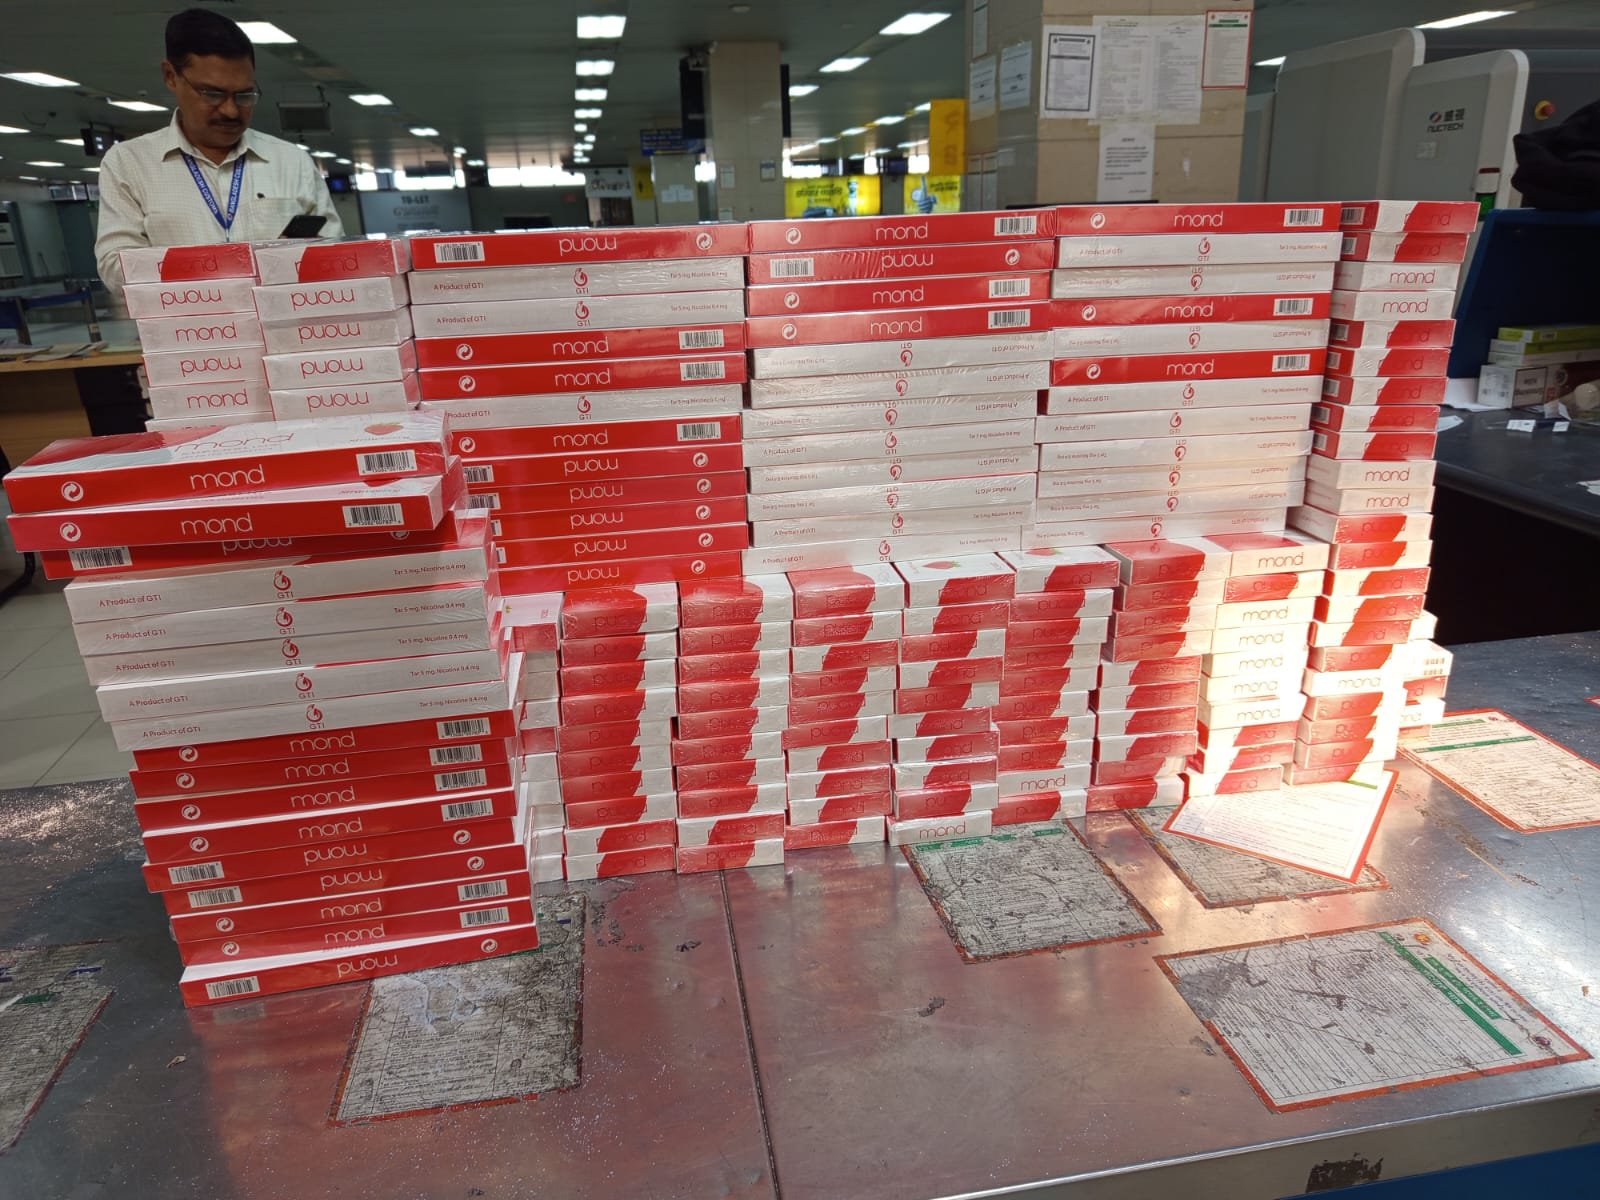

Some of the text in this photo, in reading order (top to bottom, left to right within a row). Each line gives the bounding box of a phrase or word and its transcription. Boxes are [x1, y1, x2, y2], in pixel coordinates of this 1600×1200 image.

[202, 188, 218, 214] CUSTOMS
[1174, 211, 1223, 227] mond
[876, 222, 928, 241] mond
[559, 236, 616, 256] mond
[882, 252, 933, 271] mond
[1390, 269, 1436, 284] mond
[160, 288, 222, 310] mond
[290, 288, 354, 310] mond
[873, 284, 924, 304] mond
[1165, 302, 1213, 318] mond
[1382, 299, 1429, 313] mond
[176, 322, 236, 342] mond
[298, 323, 360, 344] mond
[870, 316, 922, 335] mond
[553, 336, 608, 356] mond
[180, 356, 242, 376] mond
[301, 358, 364, 378] mond
[1167, 360, 1214, 376] mond
[555, 368, 610, 386] mond
[187, 388, 248, 408] mond
[307, 392, 370, 412] mond
[174, 432, 294, 452] mond
[554, 428, 608, 448] mond
[190, 464, 265, 489] mond
[564, 457, 618, 476] mond
[1365, 468, 1410, 482] mond
[570, 484, 623, 502] mond
[1366, 494, 1410, 508] mond
[181, 511, 253, 536] mond
[570, 511, 623, 529] mond
[574, 538, 626, 556] mond
[1259, 552, 1304, 568] mond
[568, 566, 619, 584] mond
[277, 590, 294, 599] GTI
[1243, 606, 1288, 622] mond
[280, 627, 295, 635] GTI
[1240, 632, 1284, 647] mond
[1239, 656, 1283, 670] mond
[290, 732, 355, 754] mond
[285, 758, 350, 779] mond
[1020, 774, 1066, 791] mond
[291, 786, 355, 808] mond
[298, 817, 362, 839] mond
[920, 820, 966, 839] mond
[304, 843, 366, 865] mond
[320, 869, 382, 891] mond
[320, 897, 382, 919] mond
[324, 923, 385, 944] mond
[337, 954, 398, 978] mond
